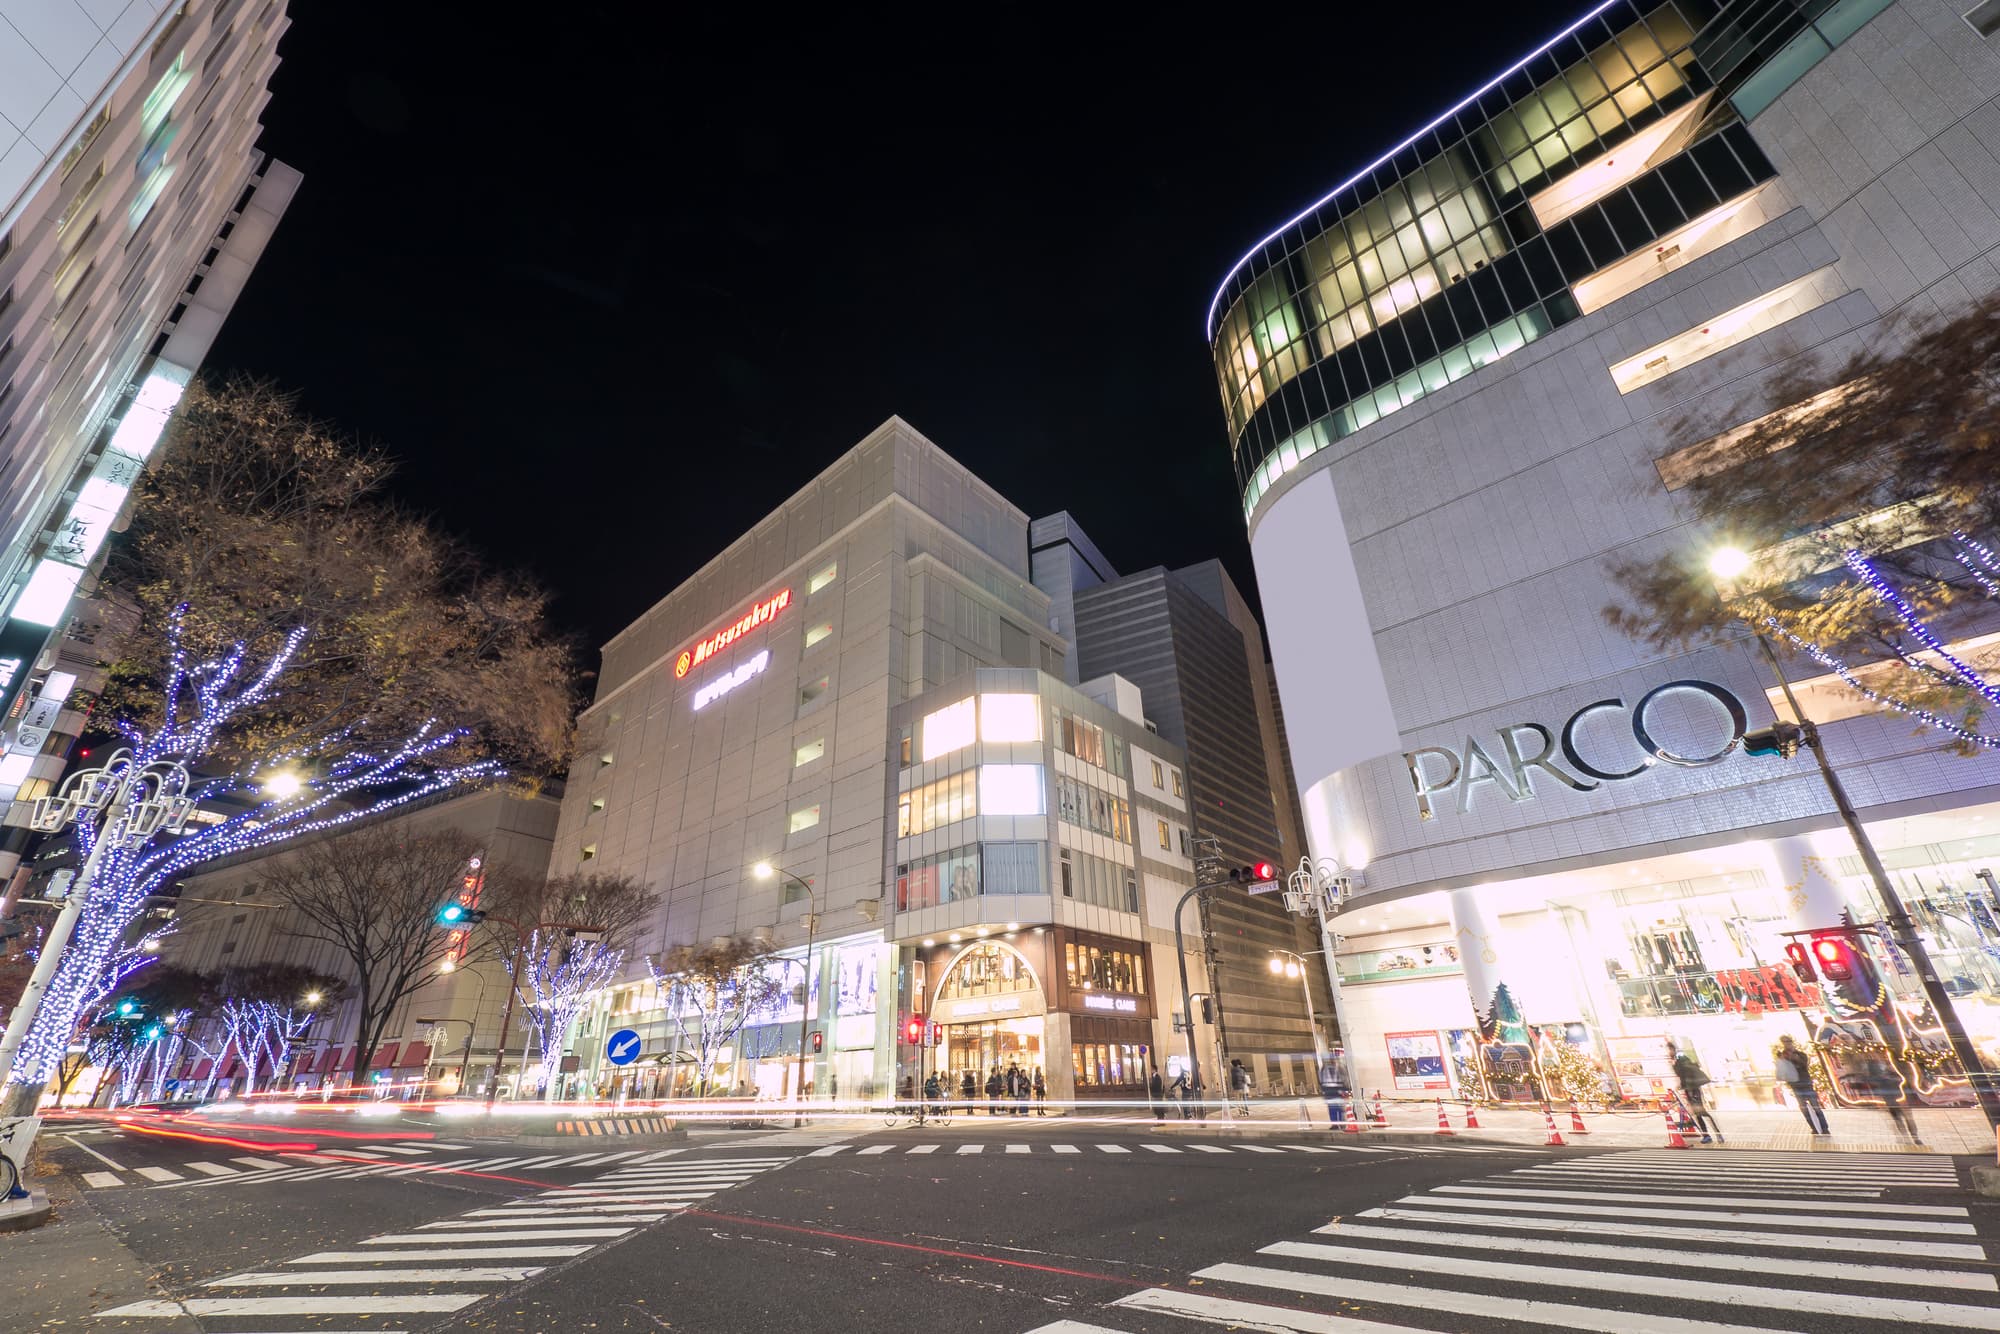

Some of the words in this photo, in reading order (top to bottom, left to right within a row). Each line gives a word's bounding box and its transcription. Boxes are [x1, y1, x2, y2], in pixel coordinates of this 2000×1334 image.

[692, 588, 792, 667] Matsuzakaya
[1402, 679, 1748, 822] PARCO
[446, 875, 478, 961] マツカヤ
